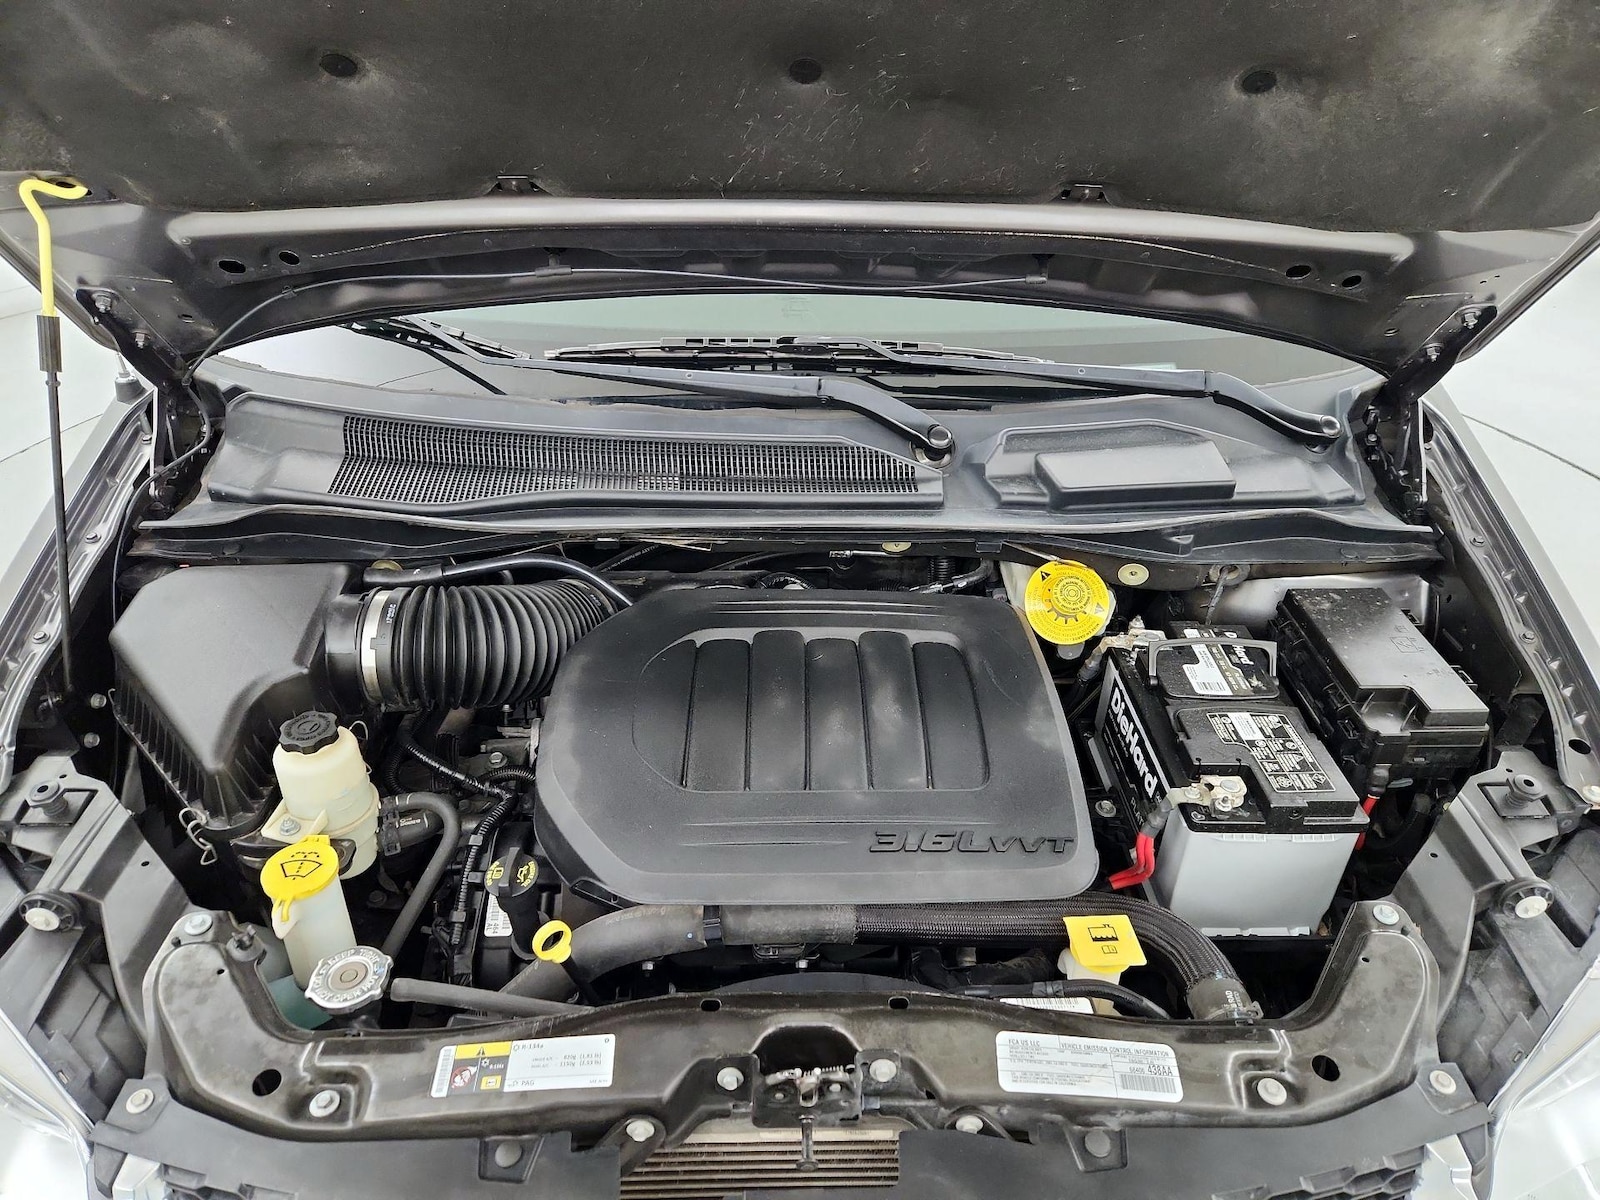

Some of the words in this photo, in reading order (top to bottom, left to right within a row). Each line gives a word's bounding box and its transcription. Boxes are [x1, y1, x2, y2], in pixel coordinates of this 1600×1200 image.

[1224, 631, 1254, 665] DHard
[1111, 687, 1158, 798] DieHard
[990, 836, 1075, 854] VVT
[1084, 1044, 1108, 1052] EMISSION
[1133, 1048, 1169, 1057] INFORMATION
[1147, 1064, 1173, 1077] 438AA
